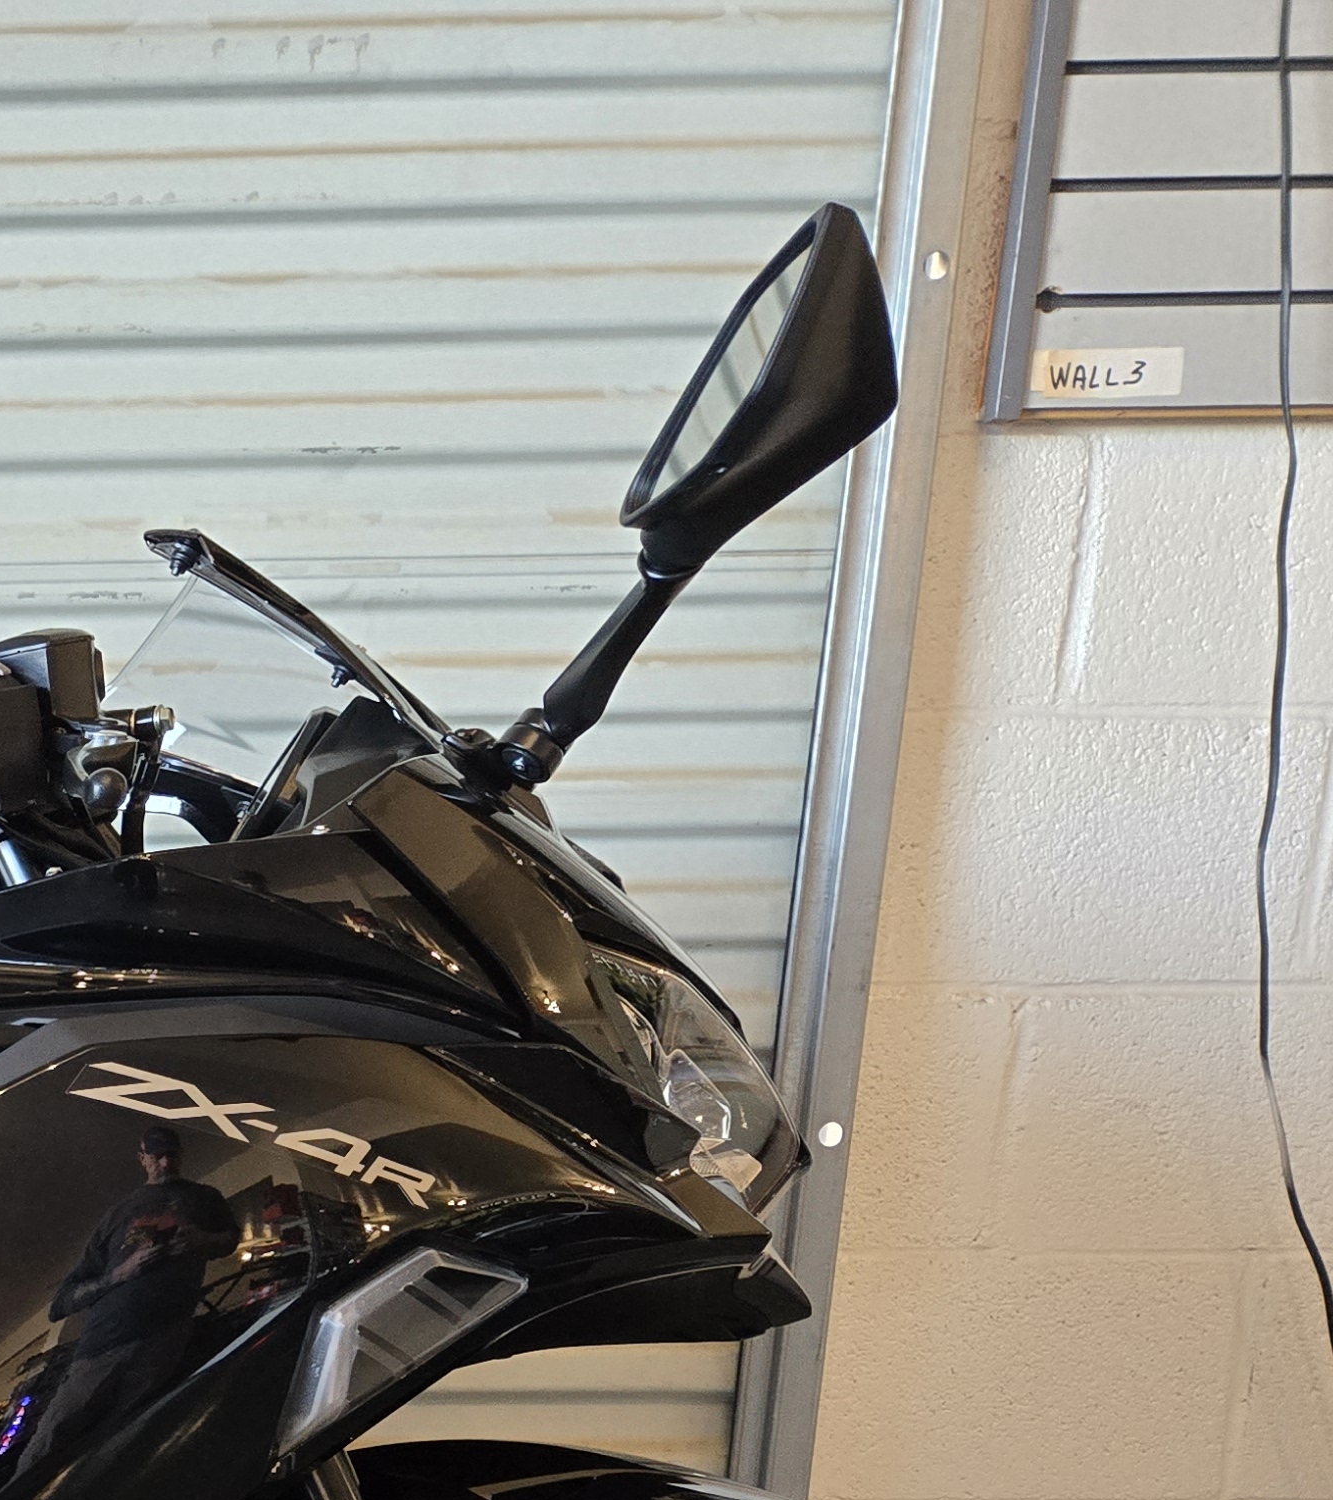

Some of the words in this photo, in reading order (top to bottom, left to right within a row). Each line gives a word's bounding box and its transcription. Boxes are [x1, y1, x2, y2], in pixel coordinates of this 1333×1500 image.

[1050, 362, 1119, 390] WALL
[1122, 361, 1147, 385] 3
[68, 1061, 436, 1210] ZX-4R
